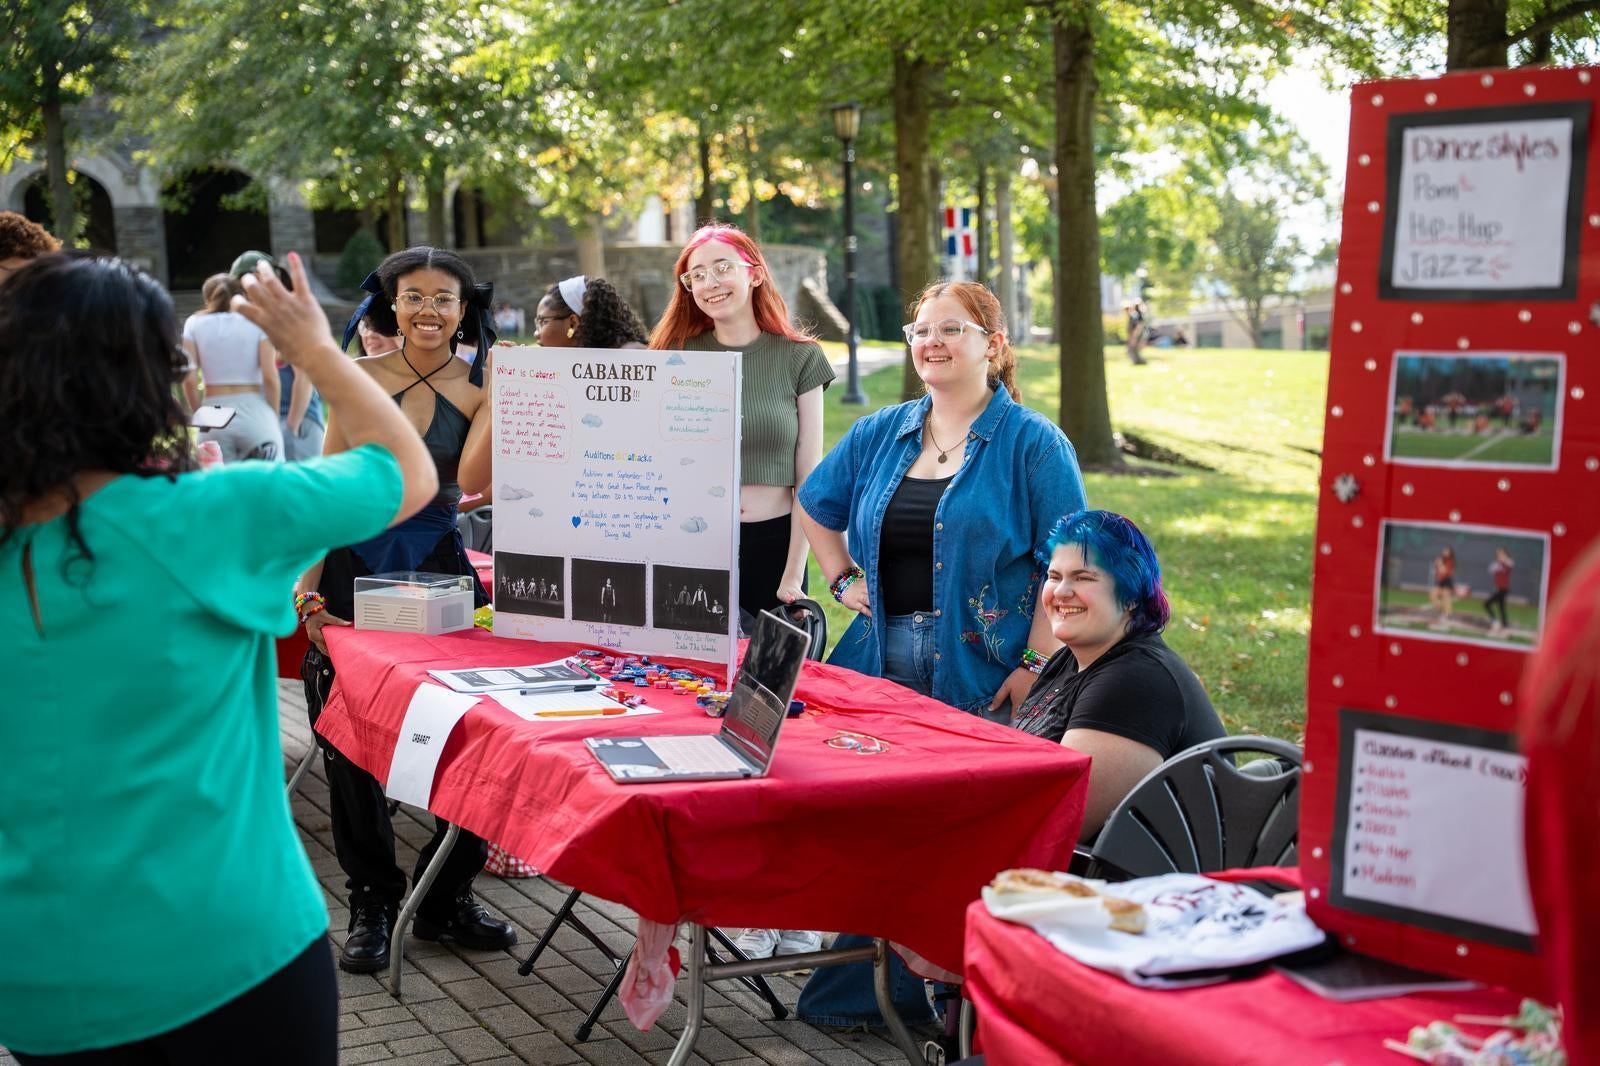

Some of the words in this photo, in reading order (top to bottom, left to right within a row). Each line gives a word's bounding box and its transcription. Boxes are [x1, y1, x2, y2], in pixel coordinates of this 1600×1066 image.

[1410, 134, 1482, 164] Dance
[1486, 130, 1561, 174] Styles
[1408, 210, 1504, 244] Hip-Hop
[1400, 251, 1489, 282] Jazz
[496, 365, 515, 376] What
[571, 362, 657, 382] CABARET
[671, 375, 712, 388] Questions?
[499, 385, 521, 398] Cabaret
[585, 384, 641, 403] CLUB!!!
[583, 450, 615, 461] Auditions
[617, 470, 642, 481] September
[577, 492, 588, 502] song
[580, 509, 608, 519] Callbacks
[633, 511, 659, 522] September
[411, 732, 431, 745] CABARET
